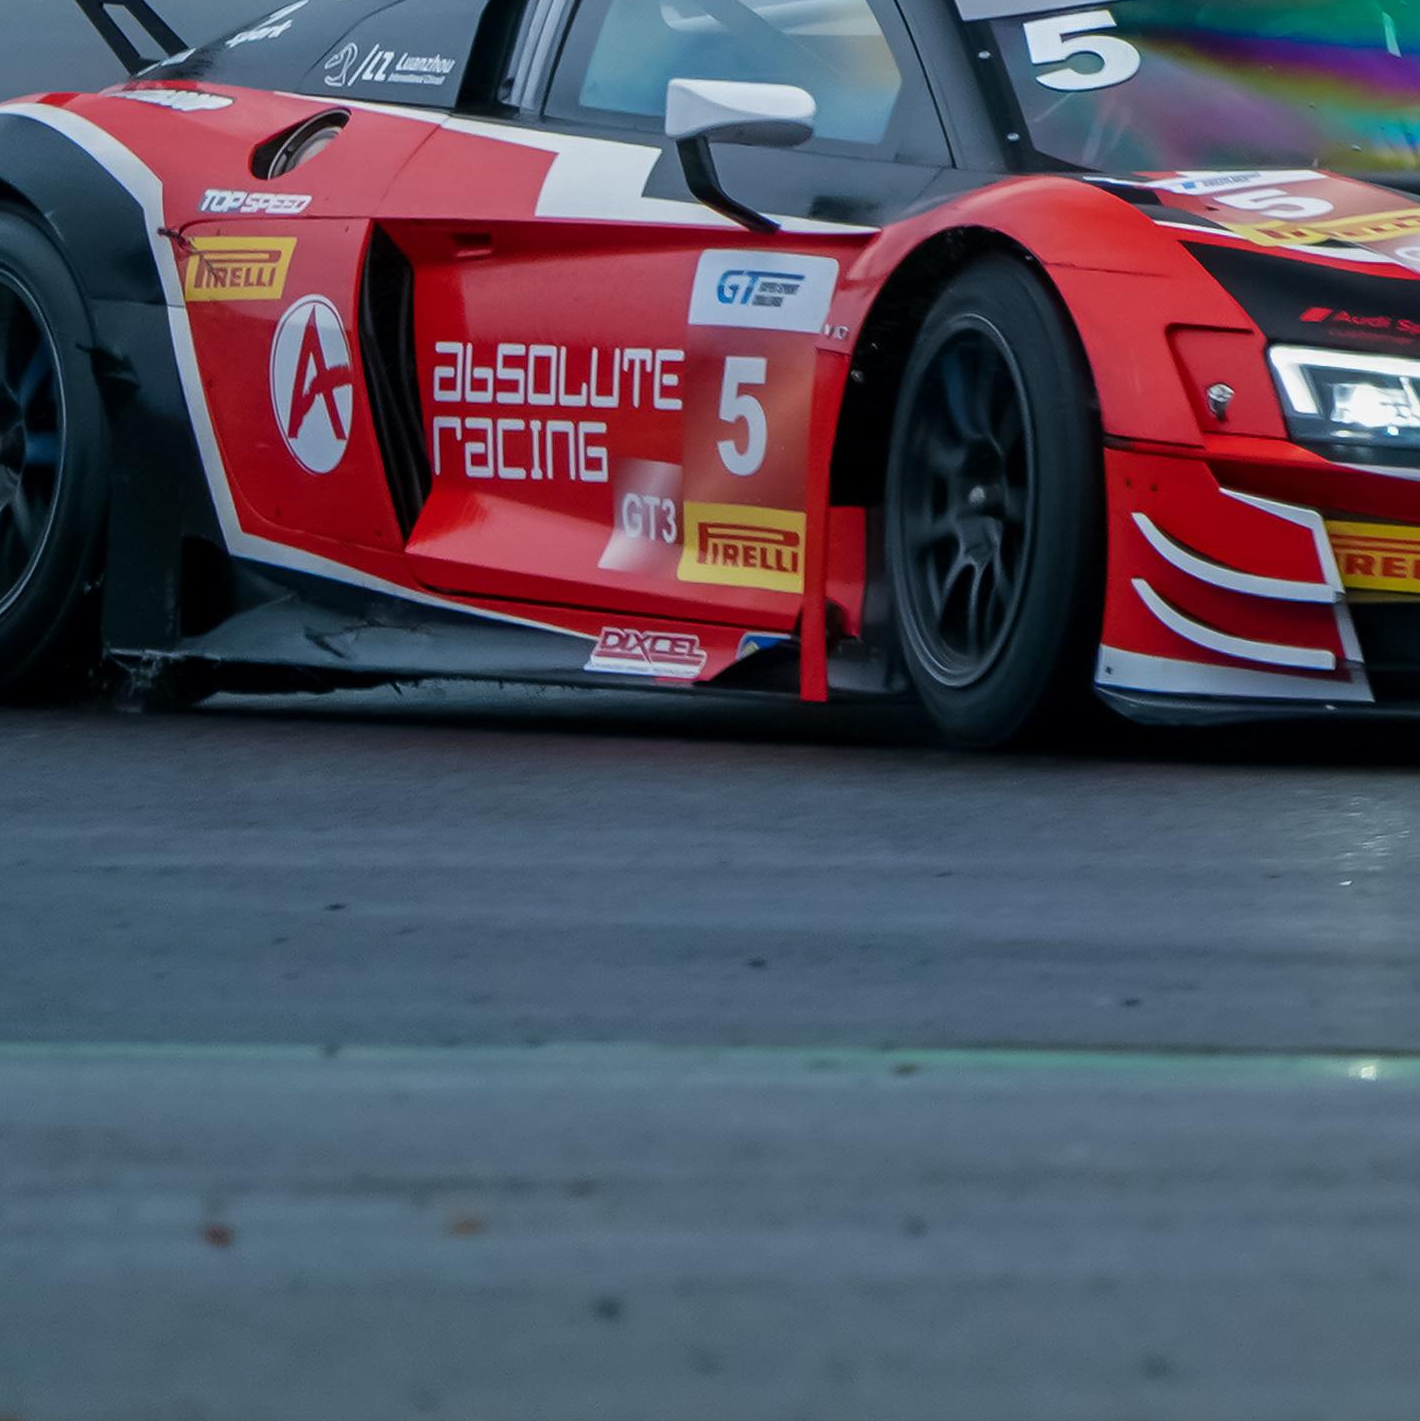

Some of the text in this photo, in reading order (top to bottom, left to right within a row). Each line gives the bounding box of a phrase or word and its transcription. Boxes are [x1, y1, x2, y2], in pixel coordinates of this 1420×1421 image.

[1022, 11, 1141, 91] 5
[240, 192, 313, 214] SPEED
[1213, 188, 1334, 219] 5
[193, 249, 283, 289] PIRELLI
[717, 269, 801, 305] GT
[716, 355, 768, 477] 5
[621, 492, 678, 544] GT3
[696, 521, 801, 574] PIRELLI
[600, 628, 699, 663] DIXCEL
